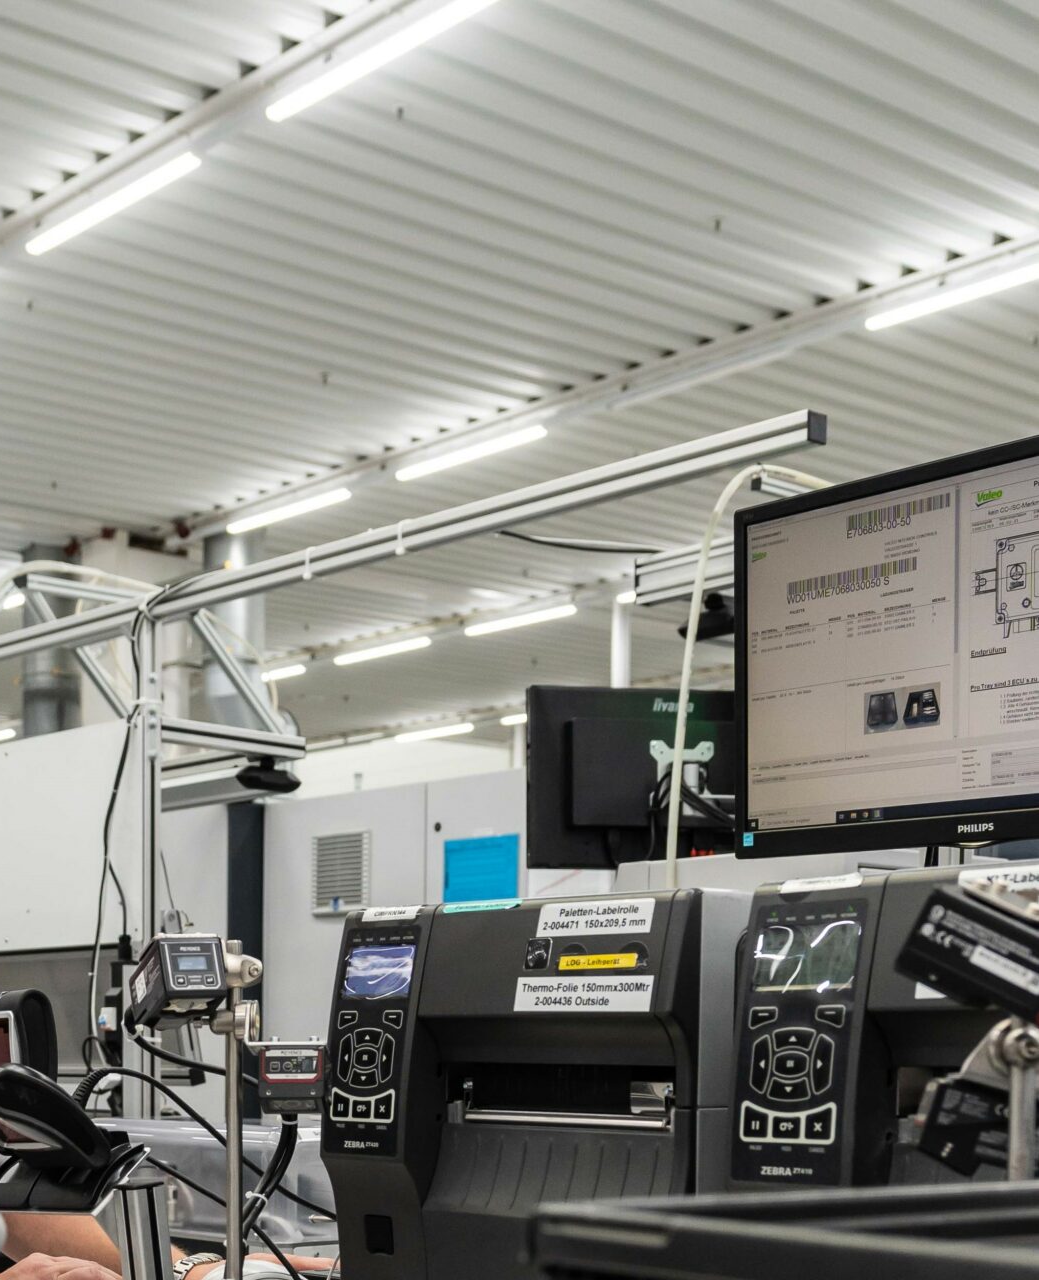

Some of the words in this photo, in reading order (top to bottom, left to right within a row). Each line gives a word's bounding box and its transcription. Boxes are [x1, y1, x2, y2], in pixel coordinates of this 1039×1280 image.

[977, 489, 1003, 503] Valeo
[846, 515, 911, 539] E706803-00-50
[786, 577, 881, 605] WD01UME7068030050
[883, 576, 890, 586] S
[970, 646, 1007, 658] Endprüfung
[652, 697, 695, 713] iiyaa
[957, 822, 994, 834] PHILIPS
[559, 904, 639, 917] Paletten-Labelrolle
[542, 920, 580, 930] 2-004471
[584, 918, 627, 929] 150x209,5
[628, 918, 646, 927] mm
[565, 959, 581, 967] LOG
[522, 982, 579, 993] Thermo-Folie
[581, 982, 650, 993] 150mmx300Mtr
[534, 995, 573, 1006] 2-004436
[574, 995, 610, 1006] Outside
[343, 1140, 366, 1149] ZEBRA
[760, 1165, 792, 1176] ZEBRA
